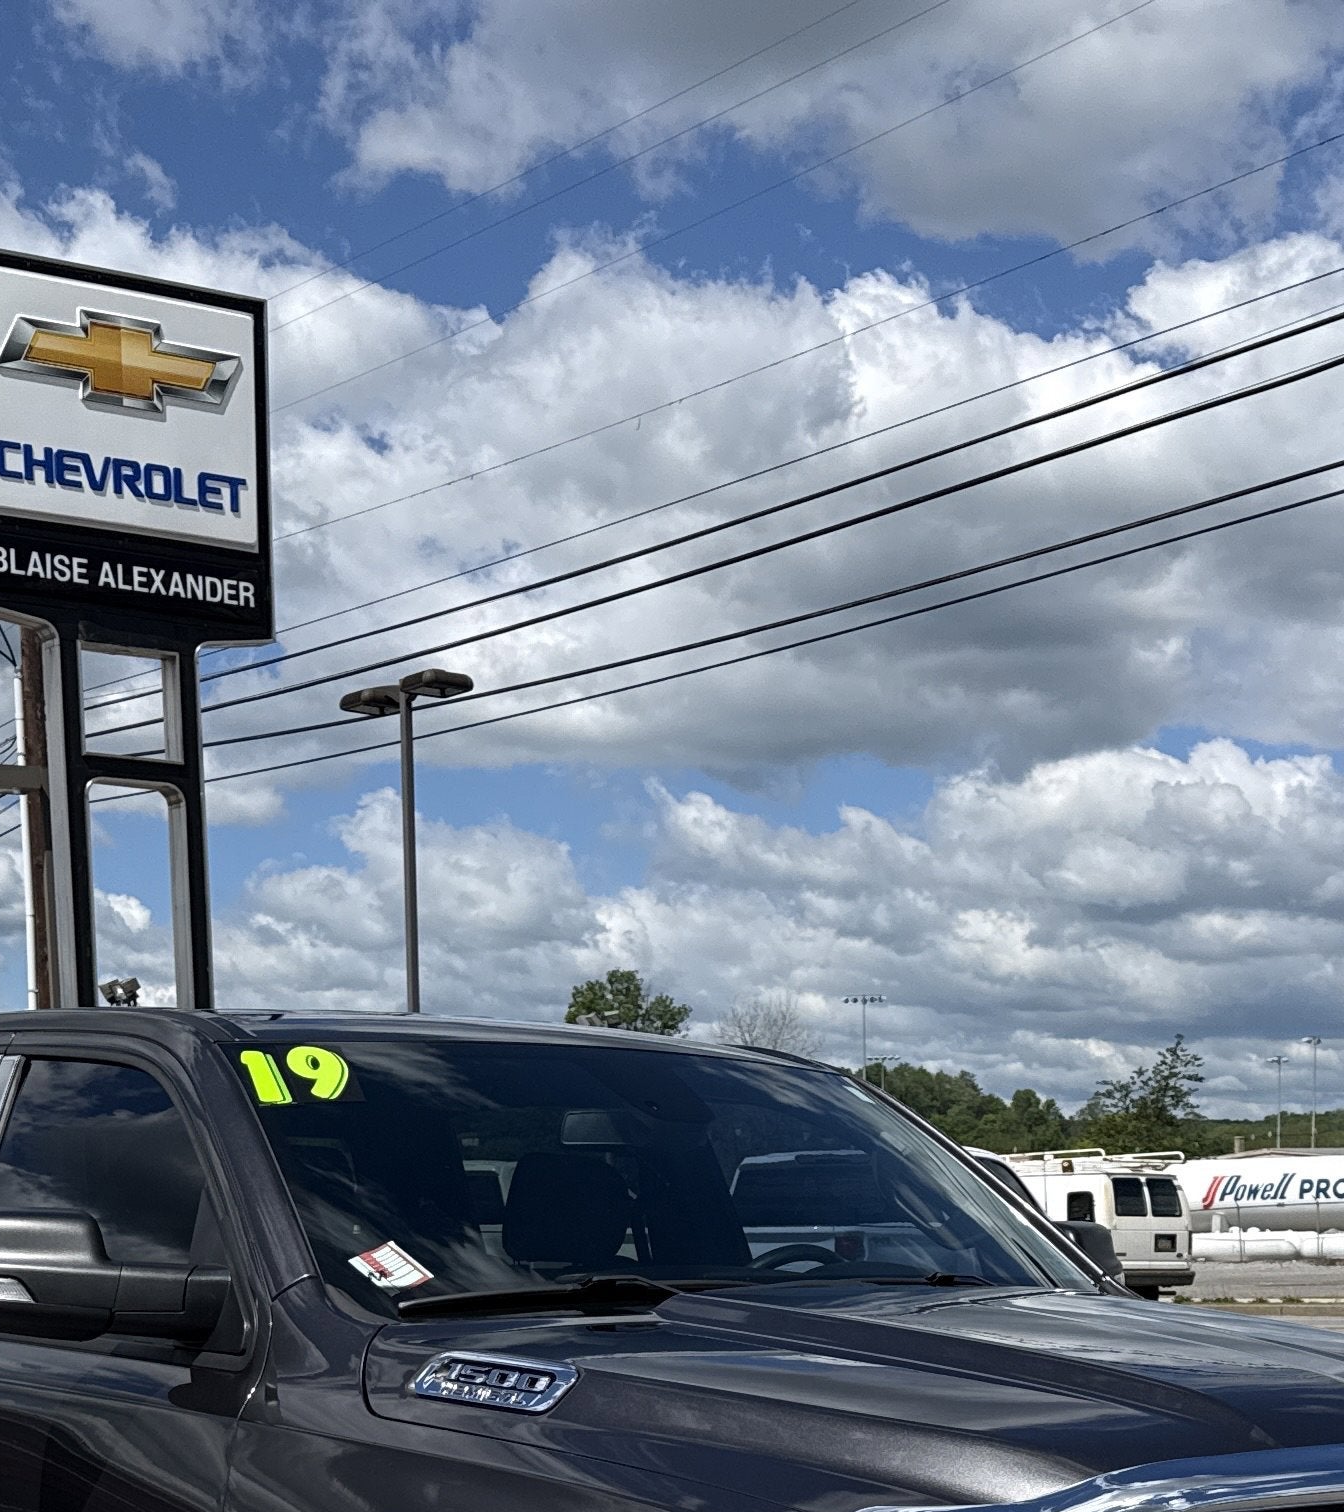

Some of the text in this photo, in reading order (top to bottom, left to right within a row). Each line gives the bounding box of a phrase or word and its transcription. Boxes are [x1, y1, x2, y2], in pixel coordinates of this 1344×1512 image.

[98, 562, 255, 607] ALEXANDER
[241, 1046, 349, 1104] 19
[446, 1361, 553, 1393] 1500
